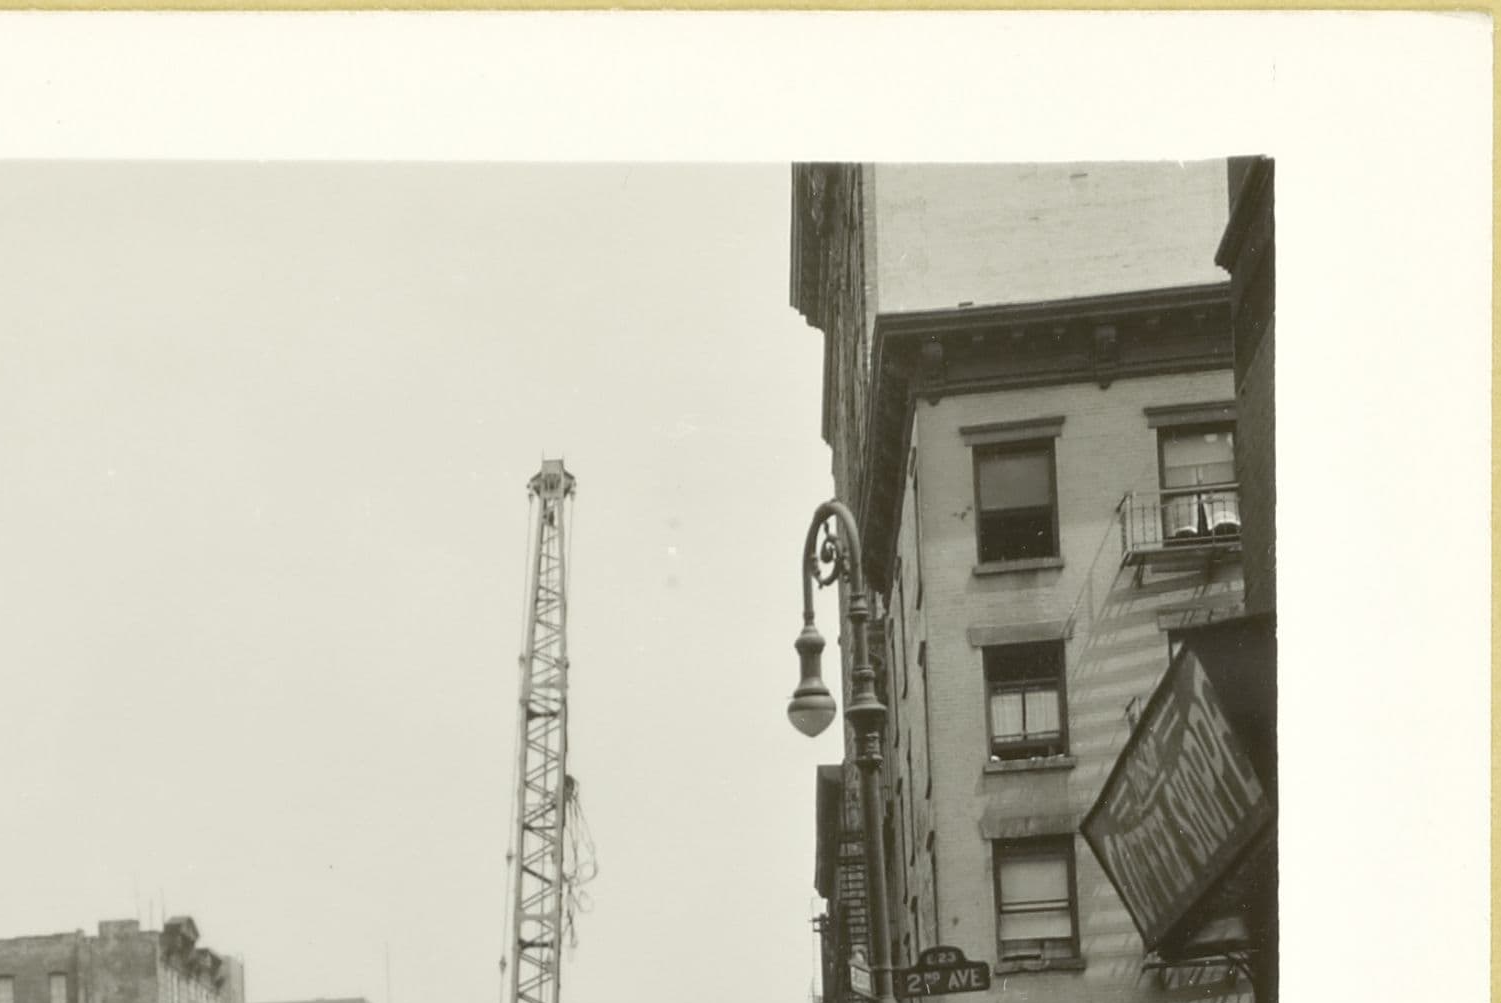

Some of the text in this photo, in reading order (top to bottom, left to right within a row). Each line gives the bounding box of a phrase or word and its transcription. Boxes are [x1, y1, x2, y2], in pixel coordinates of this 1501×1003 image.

[1103, 812, 1196, 933] COFFEE
[1165, 656, 1263, 866] SHOPPE
[906, 968, 983, 993] 2ND AVE
